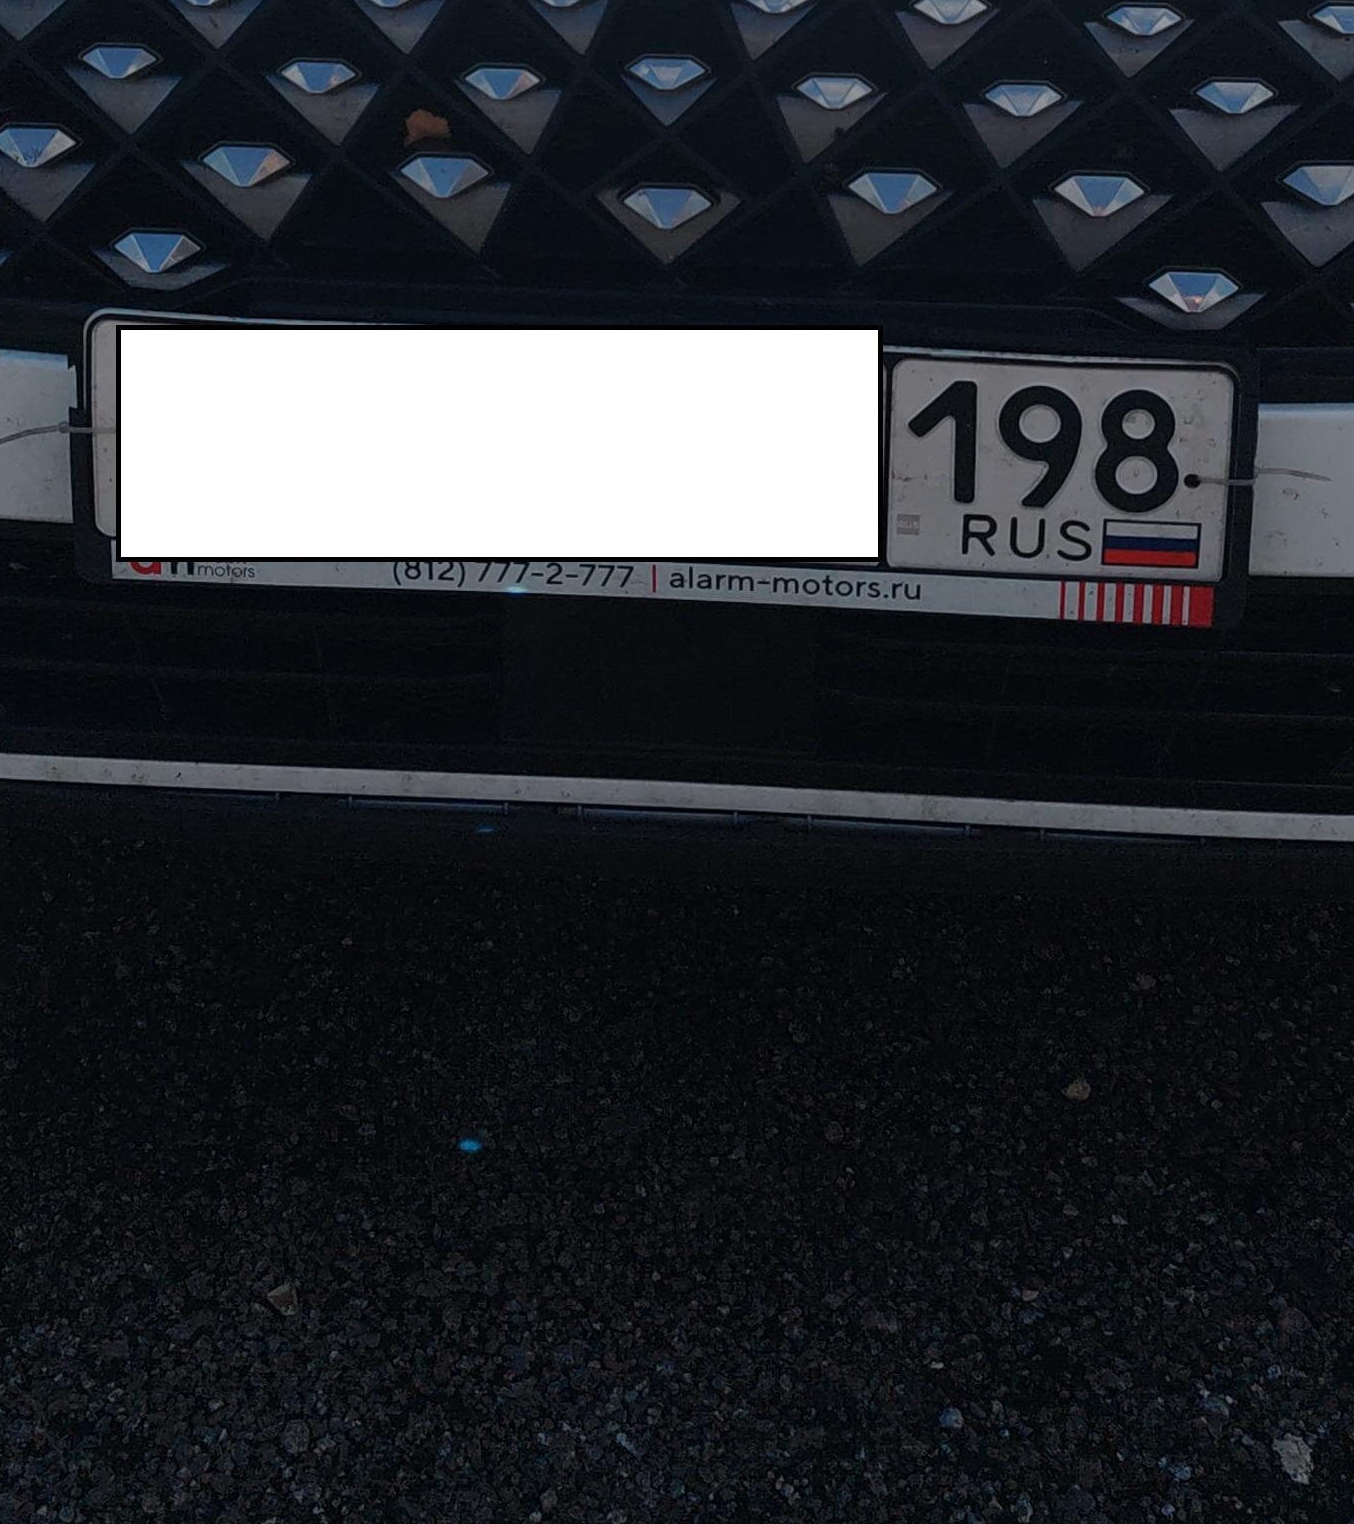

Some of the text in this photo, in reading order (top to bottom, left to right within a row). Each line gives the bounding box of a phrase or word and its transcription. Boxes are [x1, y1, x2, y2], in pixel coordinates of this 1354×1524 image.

[907, 380, 1179, 513] 198
[961, 513, 1093, 560] RUS
[197, 564, 255, 578] motors
[393, 561, 922, 602] (812) 777-2-777 alarm-motors.ru
